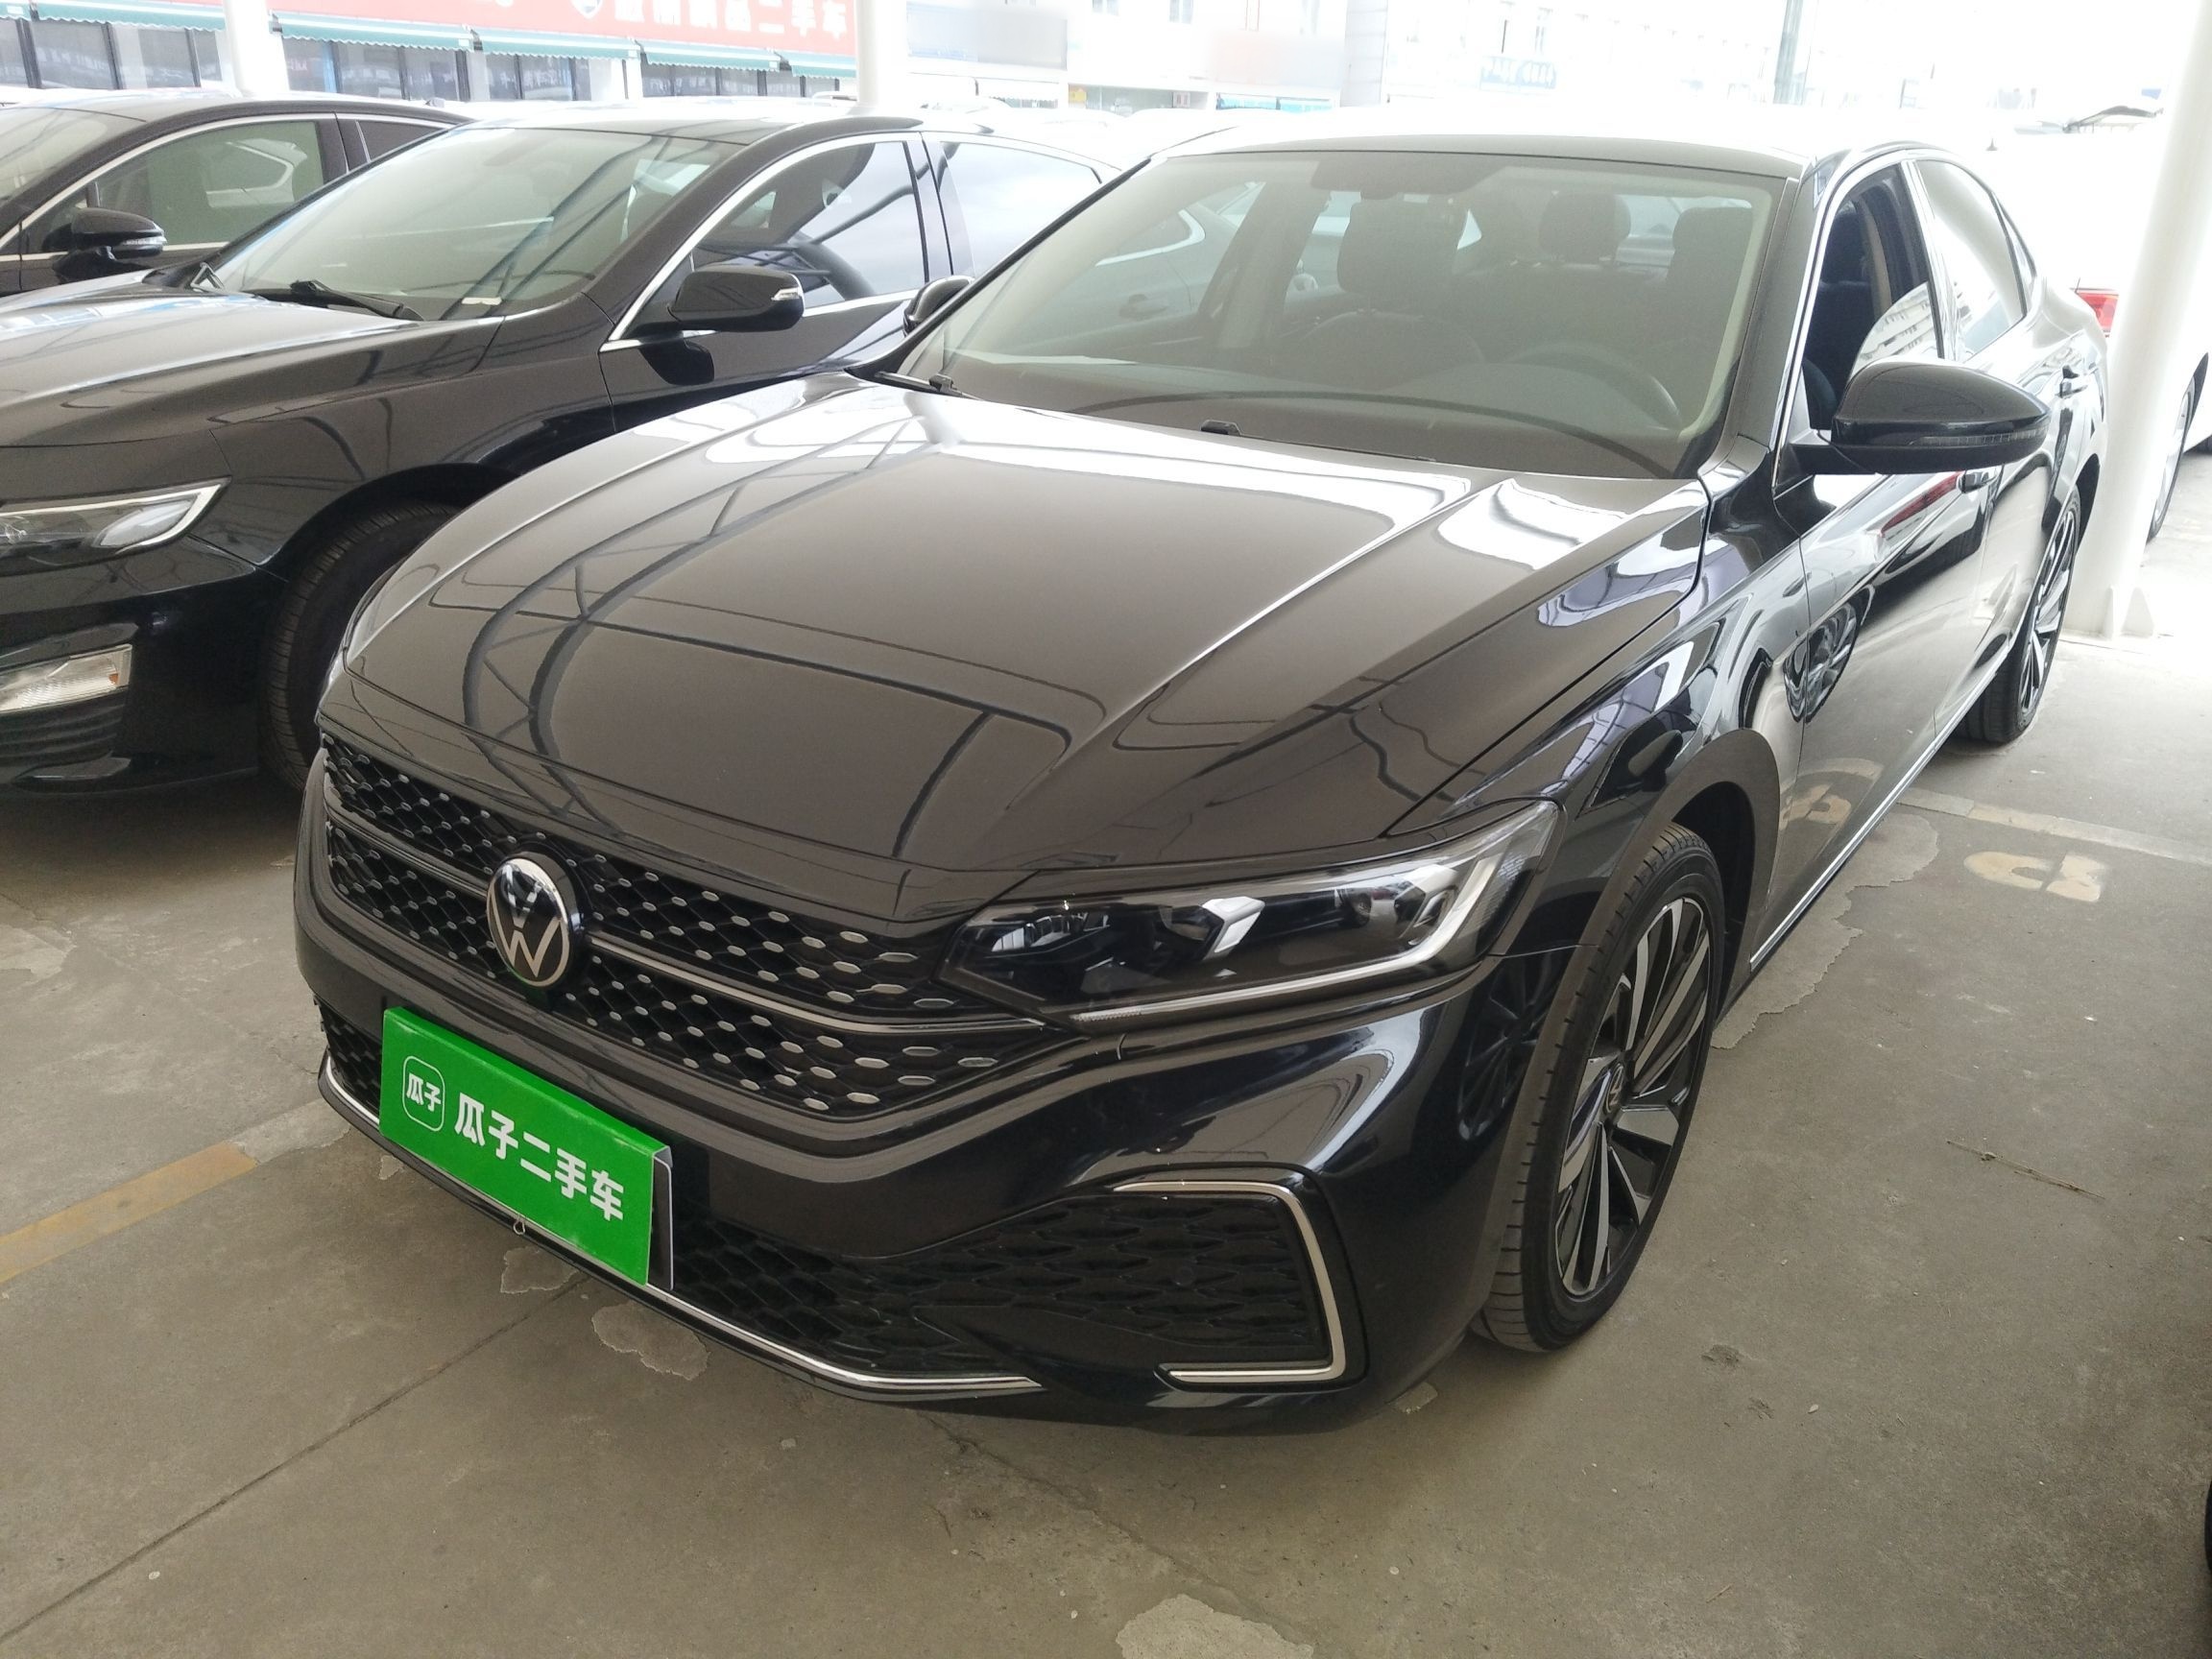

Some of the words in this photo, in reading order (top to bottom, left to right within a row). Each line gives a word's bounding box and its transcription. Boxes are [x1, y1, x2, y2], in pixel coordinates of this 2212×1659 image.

[405, 1072, 443, 1112] 瓜子
[454, 1092, 624, 1221] 瓜子二手车
